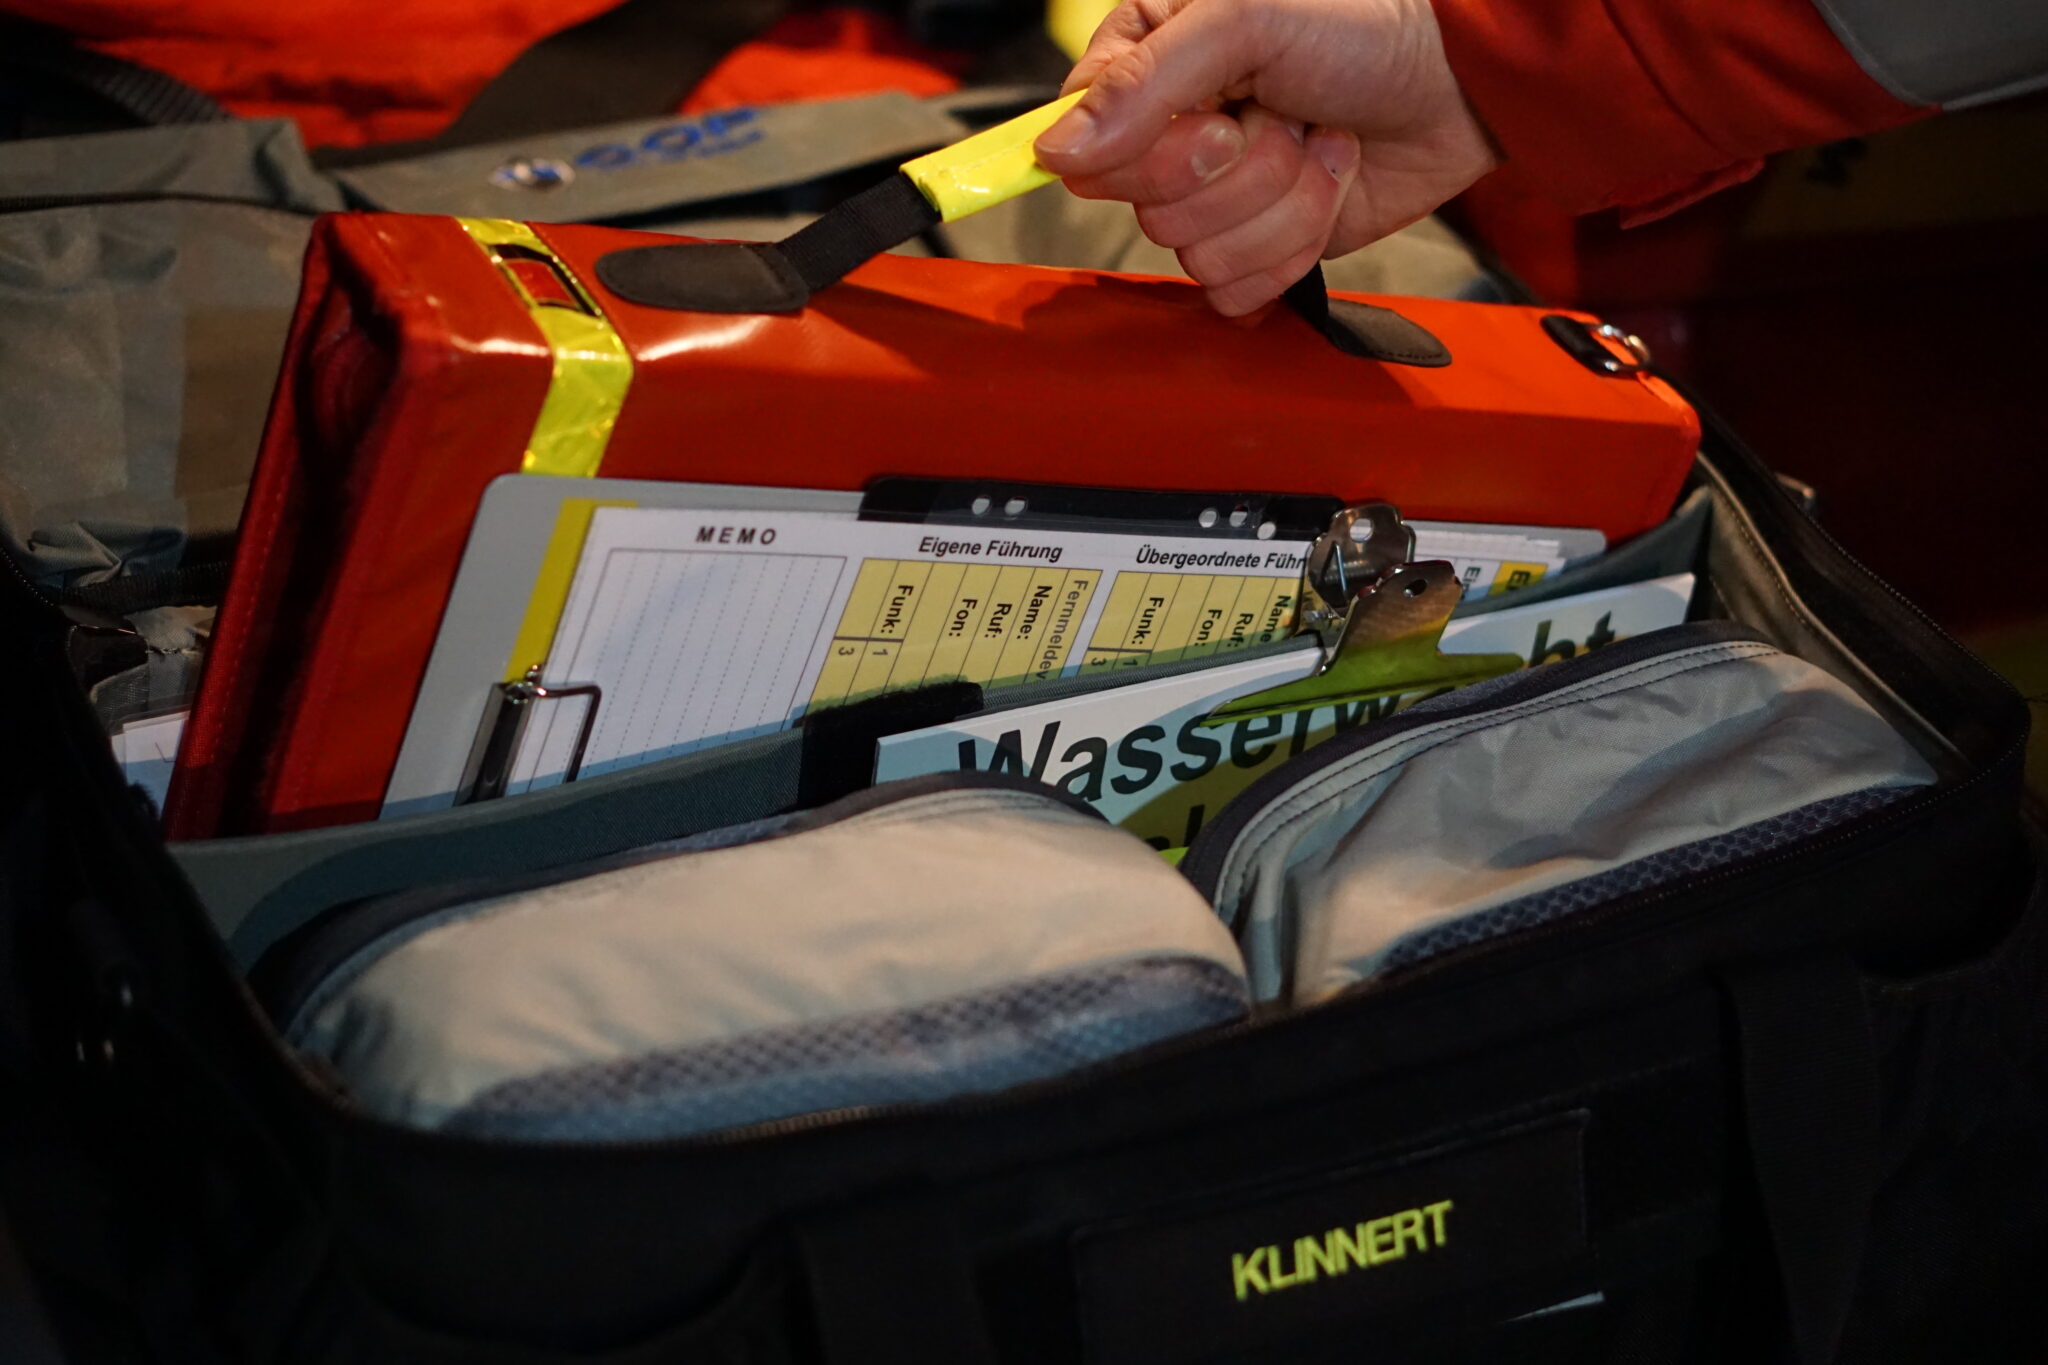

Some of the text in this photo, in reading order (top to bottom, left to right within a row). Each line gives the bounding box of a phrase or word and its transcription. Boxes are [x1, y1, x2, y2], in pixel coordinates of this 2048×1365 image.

[695, 526, 777, 545] MEMO
[918, 536, 1063, 563] Eigene Führung
[1136, 544, 1260, 569] Übergeordnete
[880, 585, 914, 633] Funk:
[949, 599, 978, 637] Fon:
[984, 602, 1013, 638] Ruf:
[1017, 585, 1053, 640] Name:
[1131, 597, 1164, 644] Funk:
[1194, 609, 1223, 646] Fon:
[1227, 612, 1255, 647] Ruf:
[838, 647, 855, 656] 3
[1231, 1199, 1454, 1300] KLINNERT
